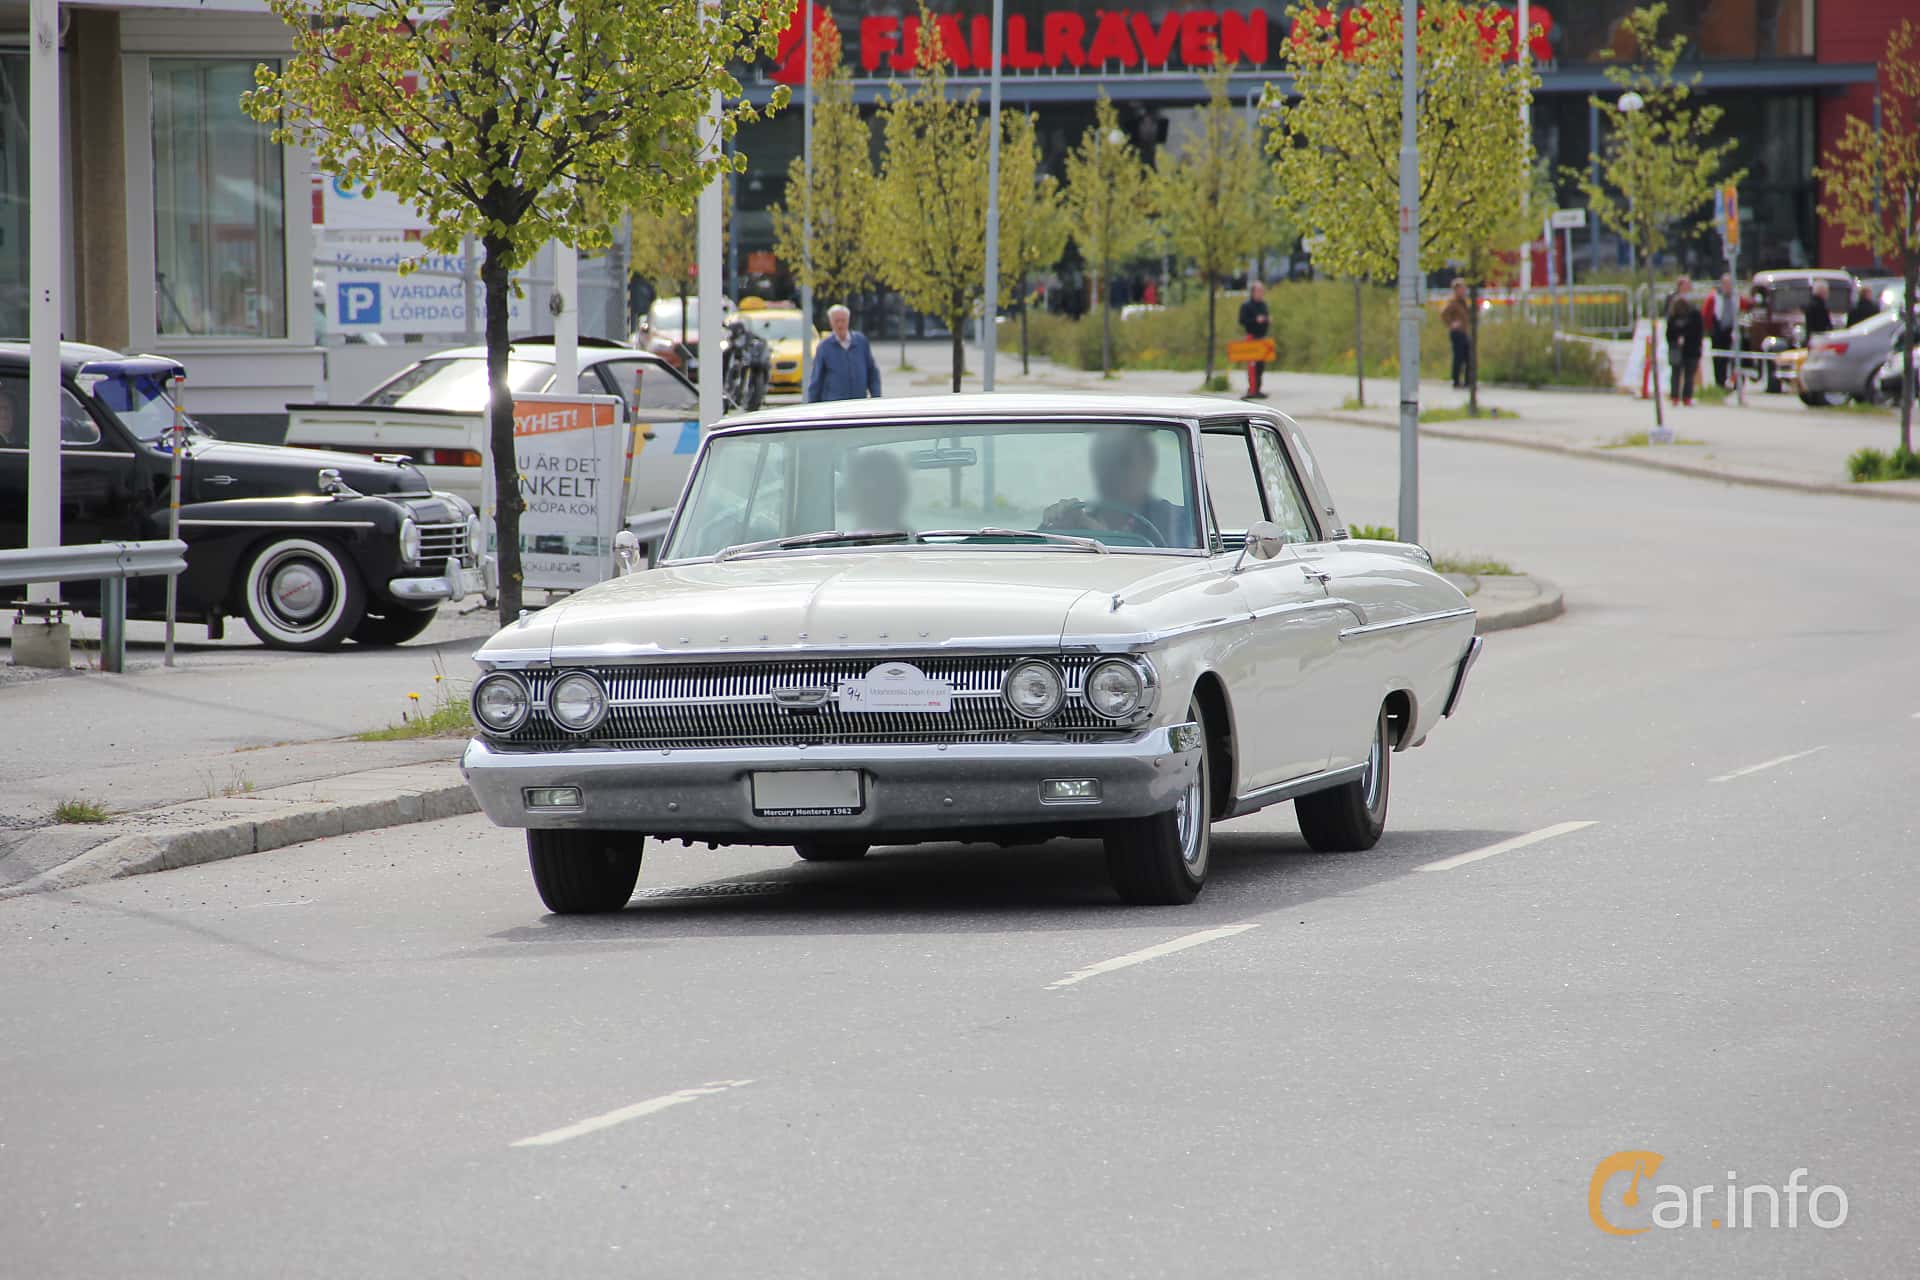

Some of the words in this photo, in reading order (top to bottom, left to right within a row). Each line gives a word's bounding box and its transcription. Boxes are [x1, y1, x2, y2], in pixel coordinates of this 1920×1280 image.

[390, 303, 465, 320] LÖRDAG
[535, 453, 559, 471] ÄR
[565, 456, 601, 473] DET
[519, 475, 601, 498] NKELT
[763, 808, 794, 817] Mercury
[796, 807, 831, 816] Monterey
